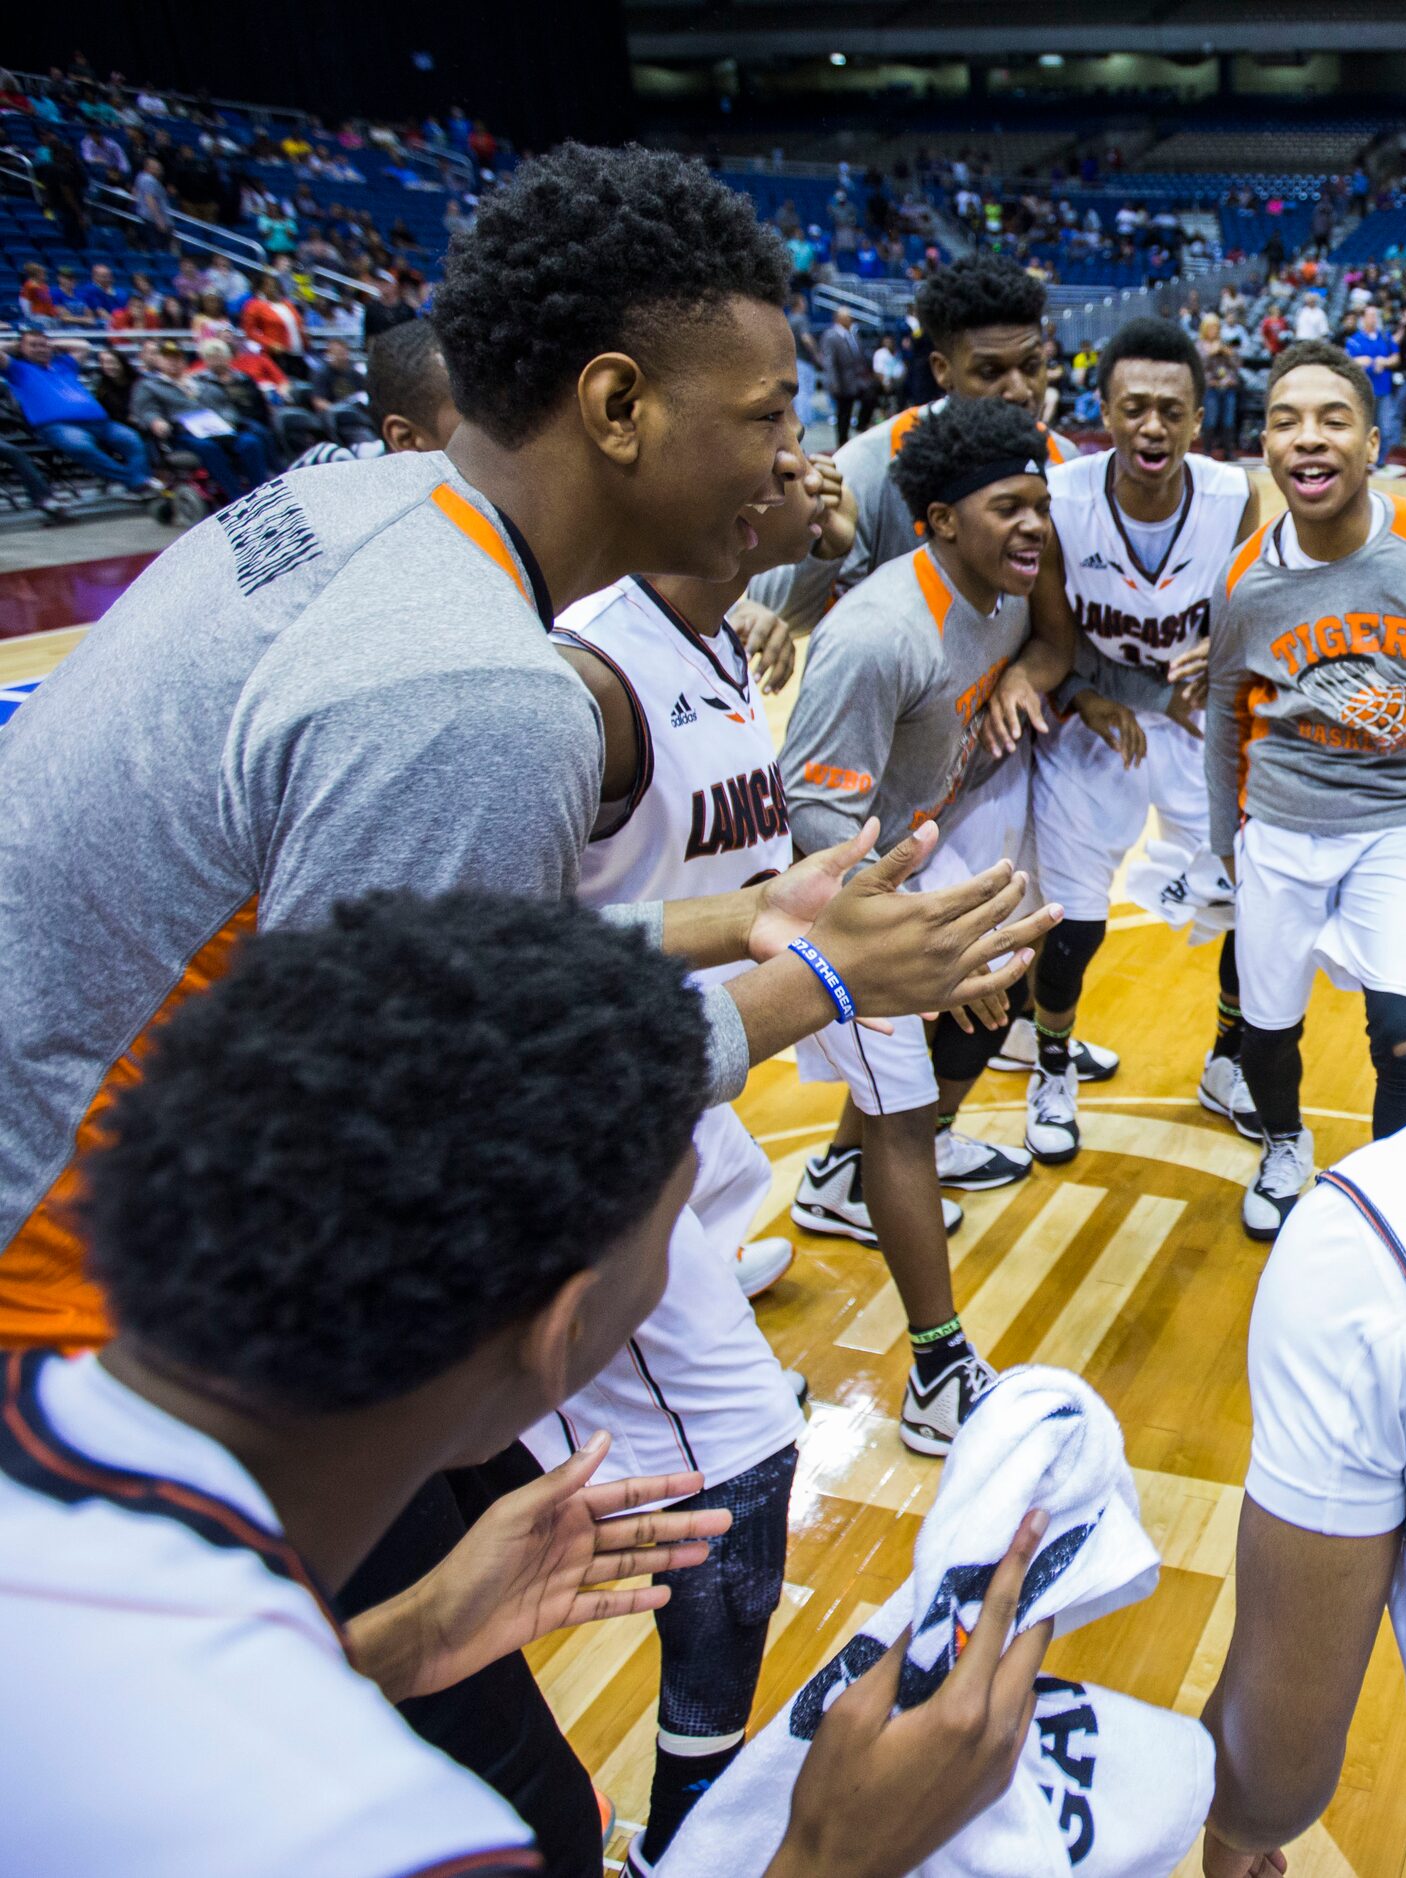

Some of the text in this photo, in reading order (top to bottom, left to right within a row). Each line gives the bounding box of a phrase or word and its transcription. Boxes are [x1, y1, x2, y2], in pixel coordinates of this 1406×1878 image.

[671, 710, 698, 729] adidas
[815, 956, 840, 988] THE
[833, 984, 855, 1018] BEAT
